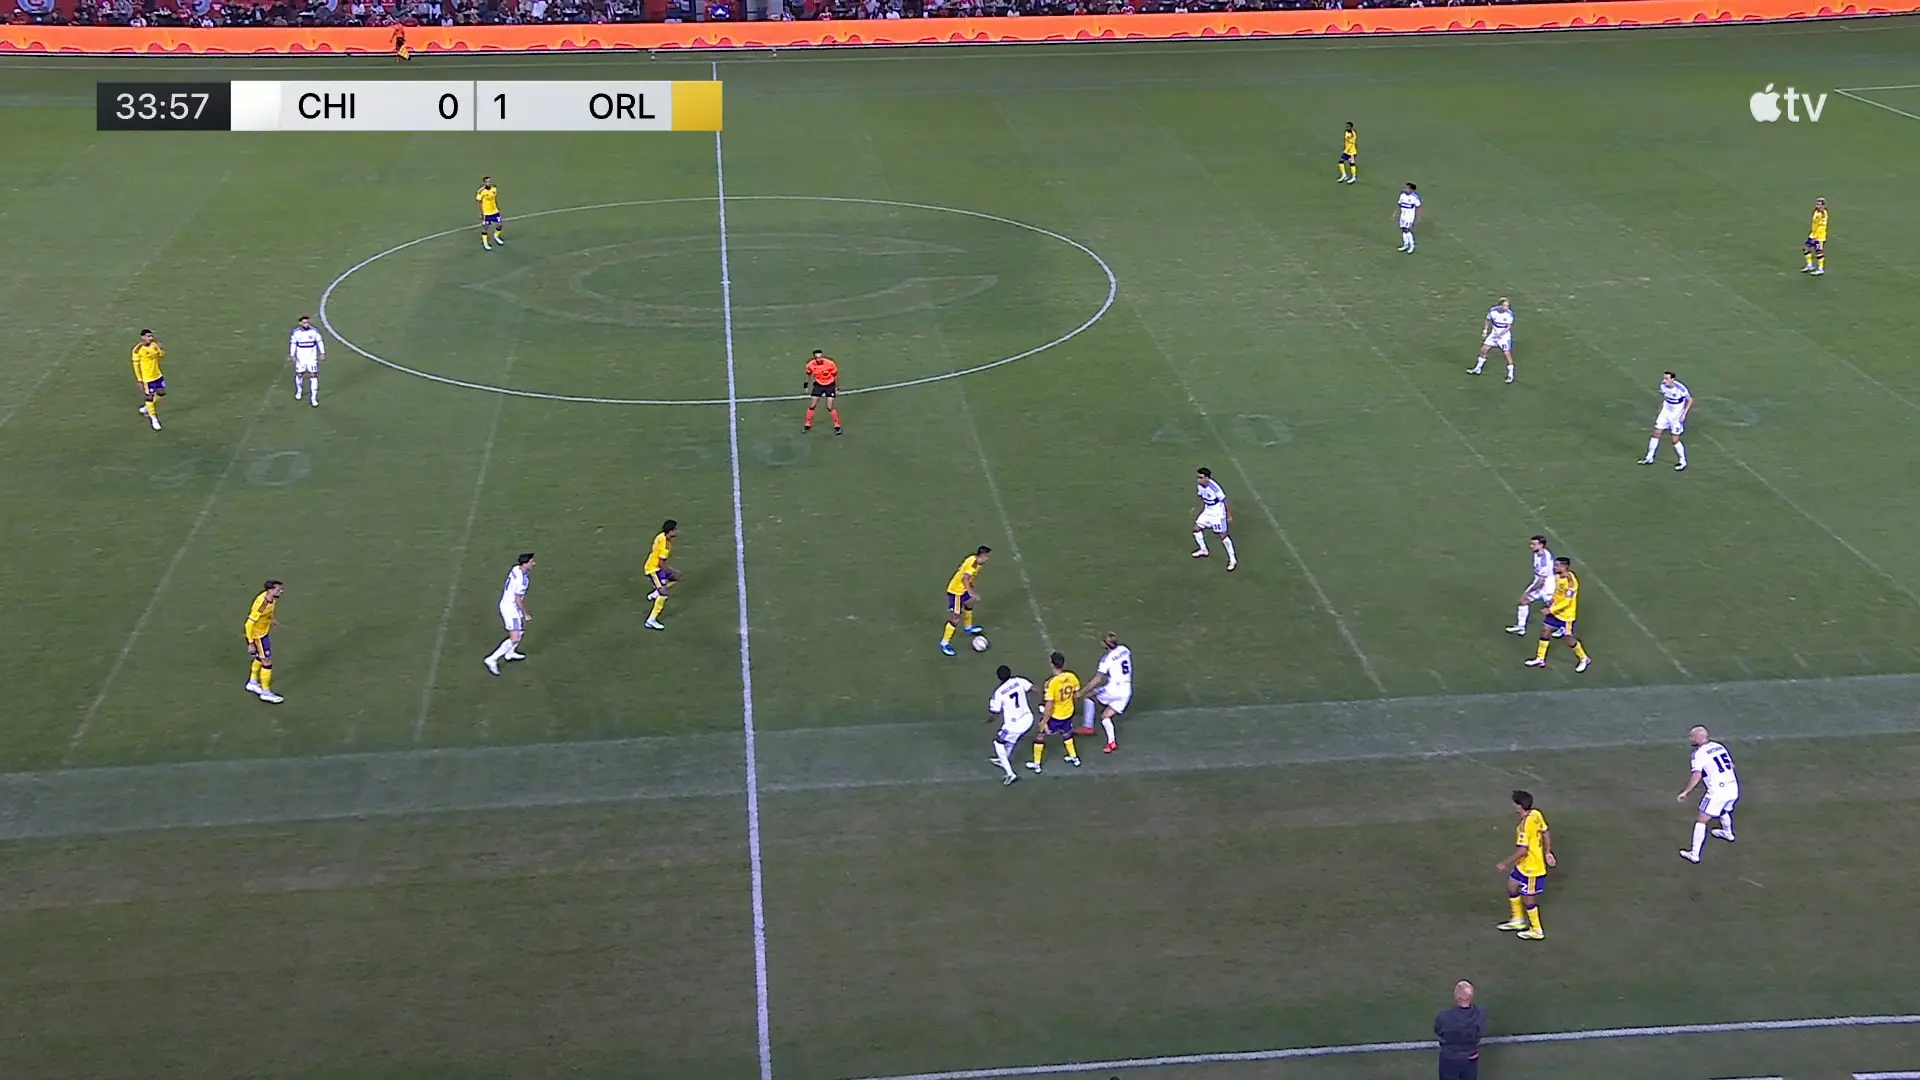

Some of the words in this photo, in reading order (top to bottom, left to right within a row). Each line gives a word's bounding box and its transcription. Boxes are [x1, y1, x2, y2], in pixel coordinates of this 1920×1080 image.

[1121, 660, 1129, 675] 6
[1009, 691, 1020, 708] 7
[1059, 686, 1073, 702] 19
[1713, 753, 1732, 774] 15
